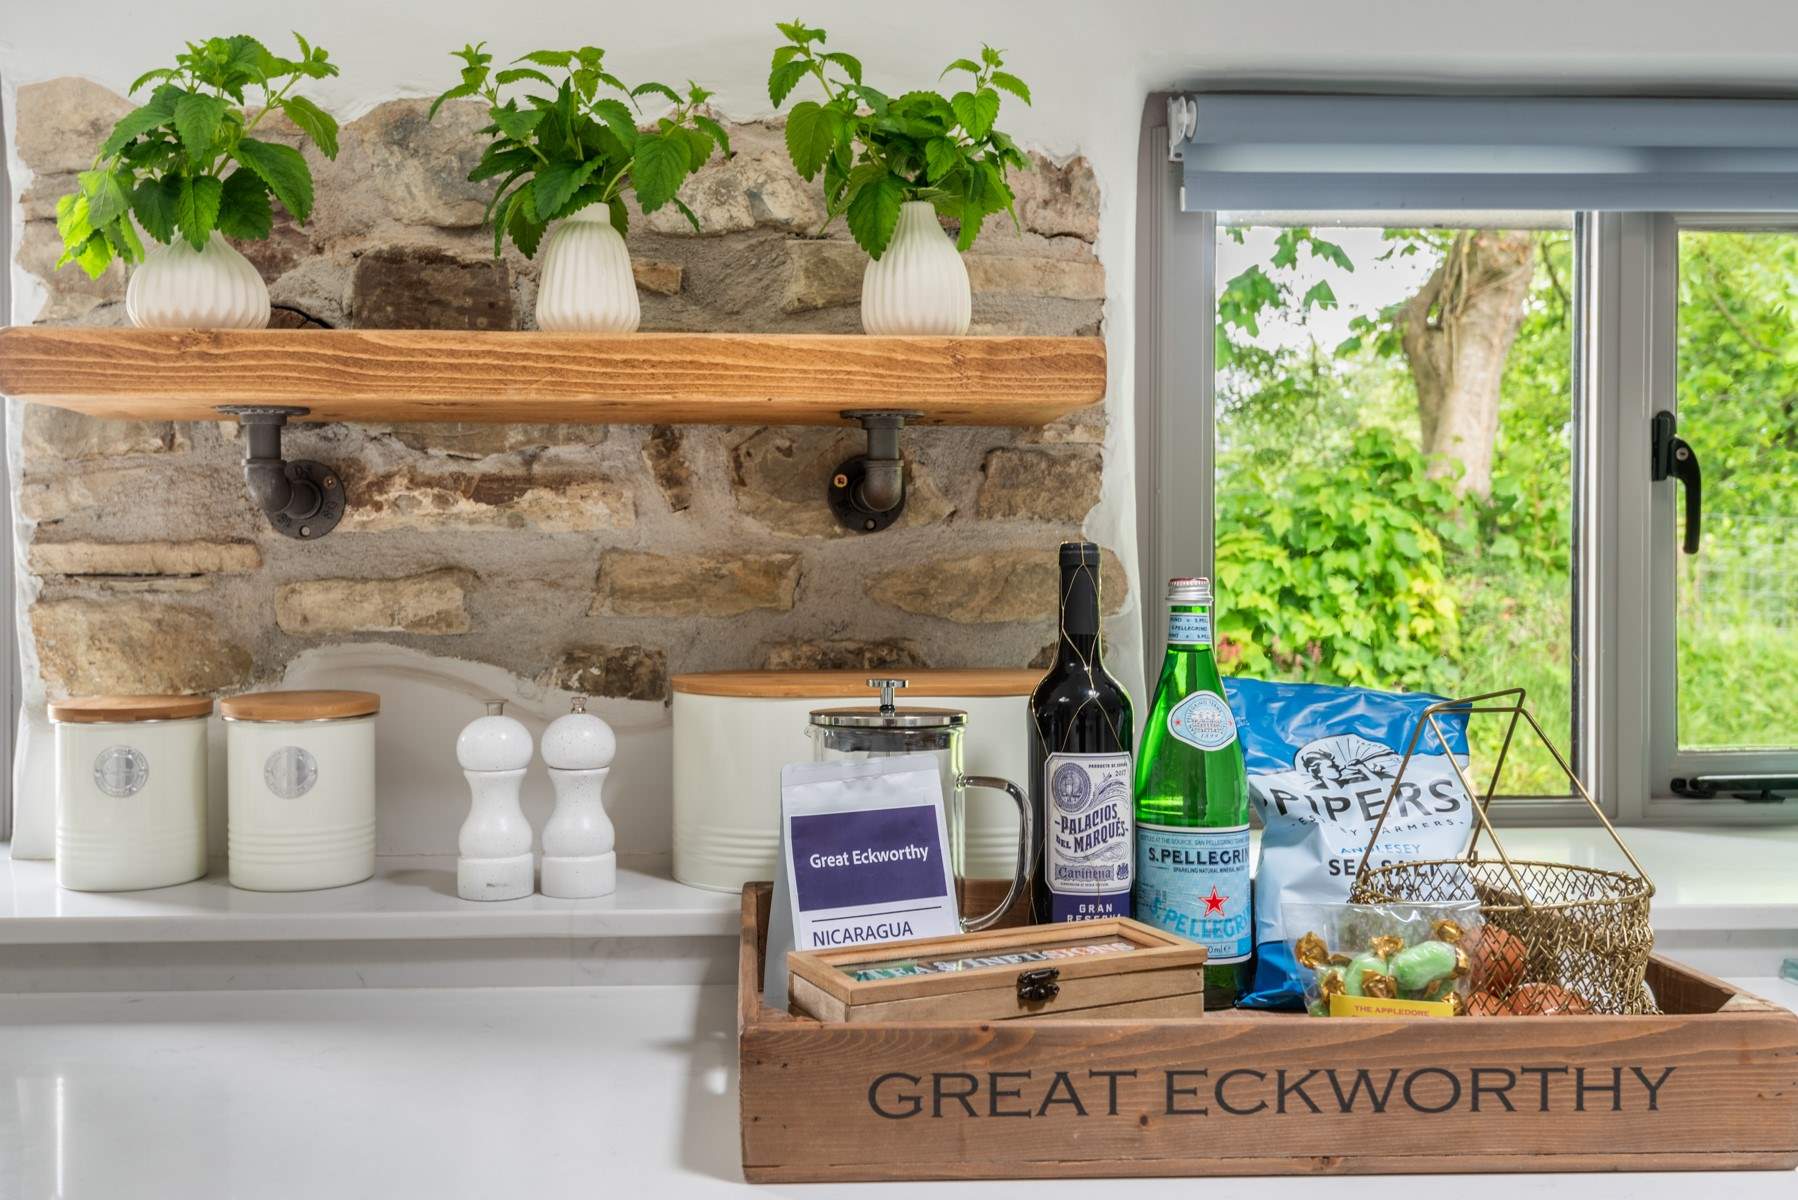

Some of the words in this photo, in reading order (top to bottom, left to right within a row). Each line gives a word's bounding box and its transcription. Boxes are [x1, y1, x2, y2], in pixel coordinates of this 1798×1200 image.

[1269, 778, 1461, 822] PIPERS
[1056, 834, 1072, 849] DEL
[809, 851, 849, 869] Great
[852, 844, 929, 865] Eckworthy
[1079, 903, 1113, 914] GRAN
[813, 921, 914, 947] NICARAGUA
[855, 965, 928, 982] TEA
[1354, 1005, 1372, 1013] THE
[1376, 1006, 1430, 1017] APPLEDORE
[867, 1069, 1138, 1120] GREAT
[1164, 1065, 1678, 1117] ECKWORTHY
